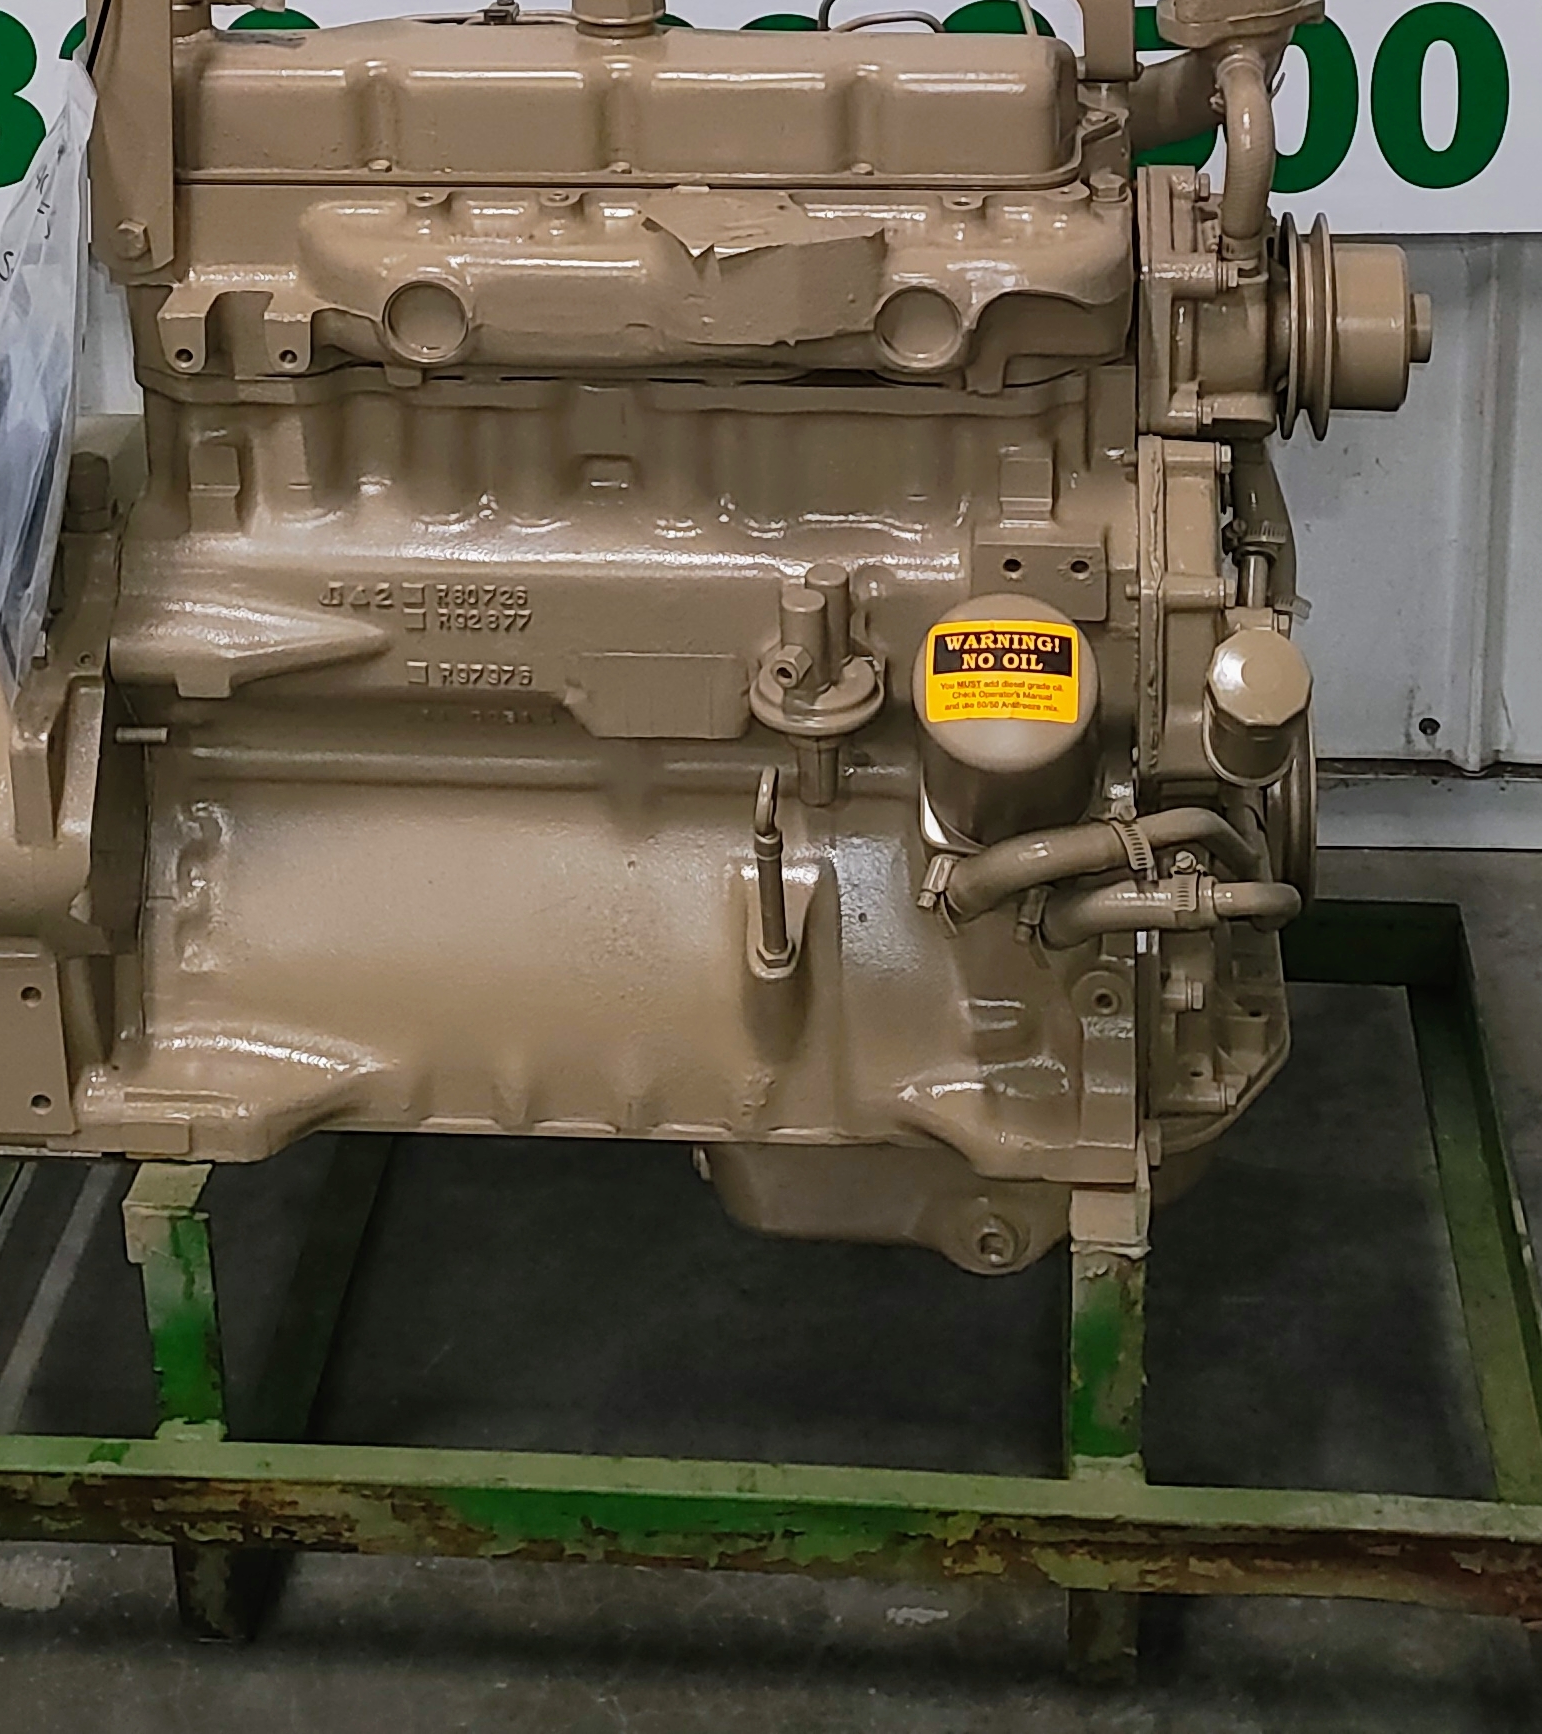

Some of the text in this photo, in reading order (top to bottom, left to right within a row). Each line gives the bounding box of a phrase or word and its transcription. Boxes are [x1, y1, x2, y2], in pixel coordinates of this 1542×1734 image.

[944, 632, 1060, 653] WARNING!
[961, 652, 1044, 671] NO OIL
[940, 682, 955, 690] You
[956, 680, 982, 689] MUST
[984, 679, 1000, 688] add
[1001, 680, 1025, 688] diesel
[1027, 682, 1051, 691] grade
[952, 690, 977, 699] Check
[1022, 691, 1053, 701] Manual
[944, 701, 960, 711] and
[1000, 700, 1042, 711] Antifreeze
